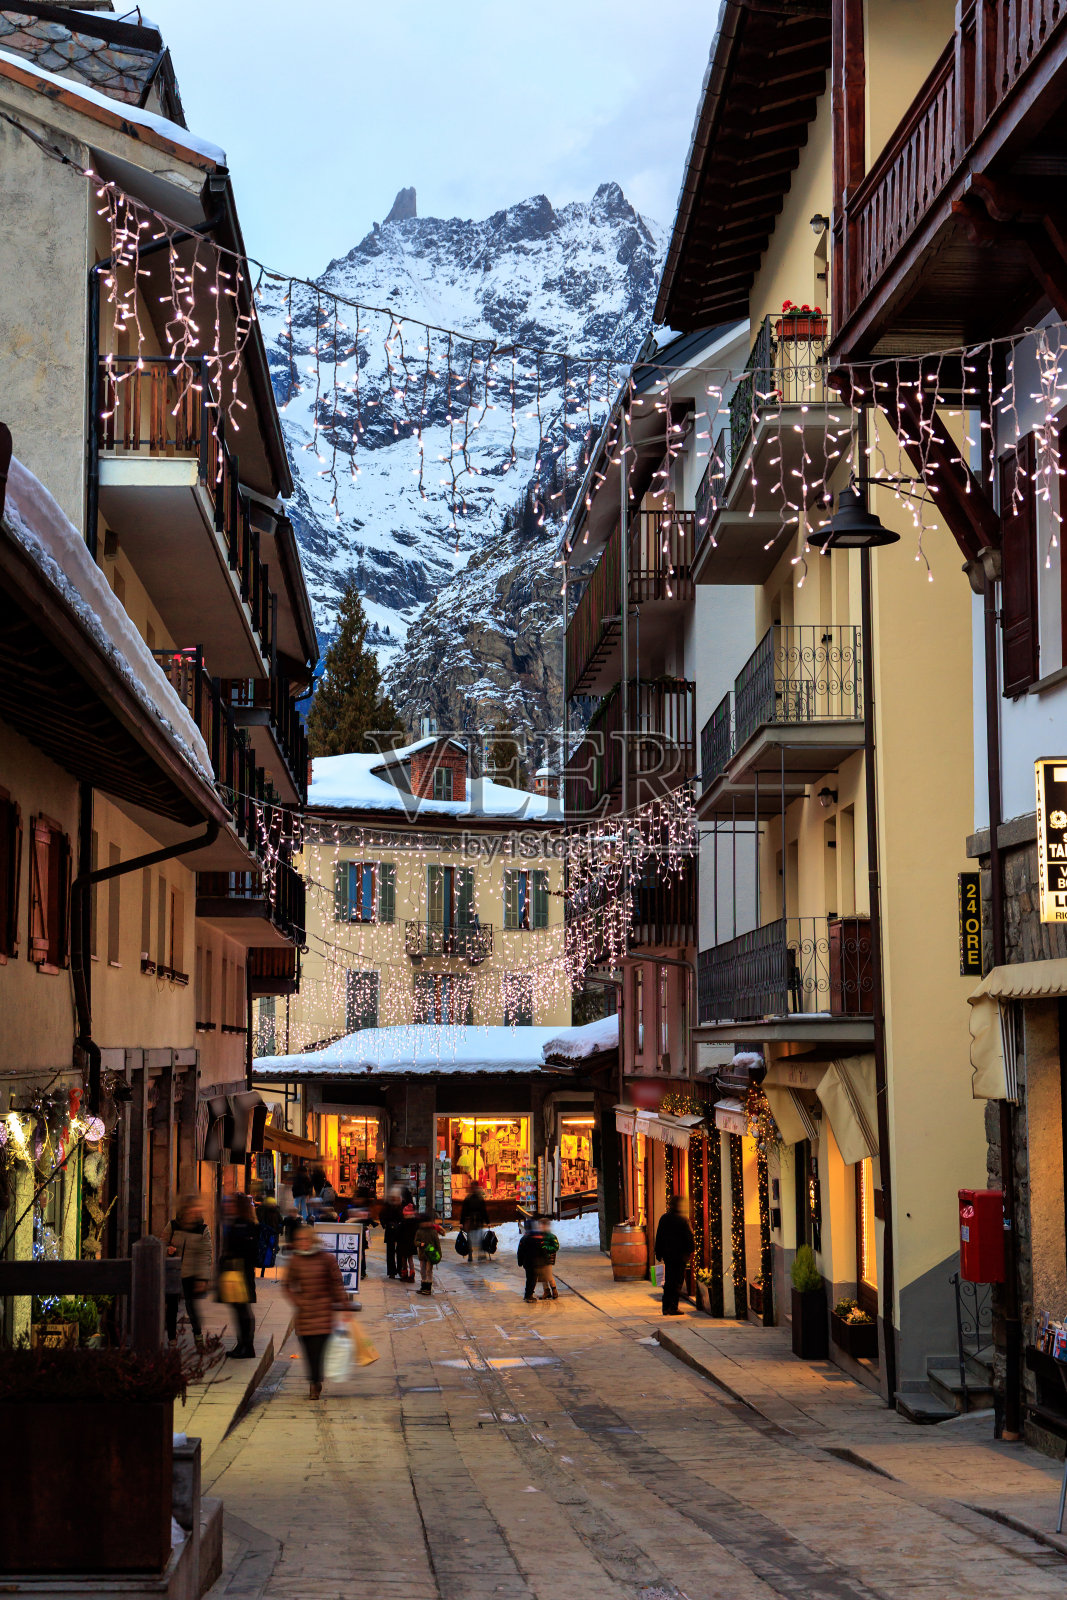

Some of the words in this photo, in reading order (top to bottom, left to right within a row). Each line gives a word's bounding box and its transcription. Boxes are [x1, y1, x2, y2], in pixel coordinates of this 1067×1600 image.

[1036, 770, 1045, 916] TABACCHI
[1048, 843, 1067, 858] TA
[1057, 878, 1067, 889] B
[966, 884, 977, 914] 24
[1055, 895, 1067, 908] L
[965, 918, 980, 965] ORE
